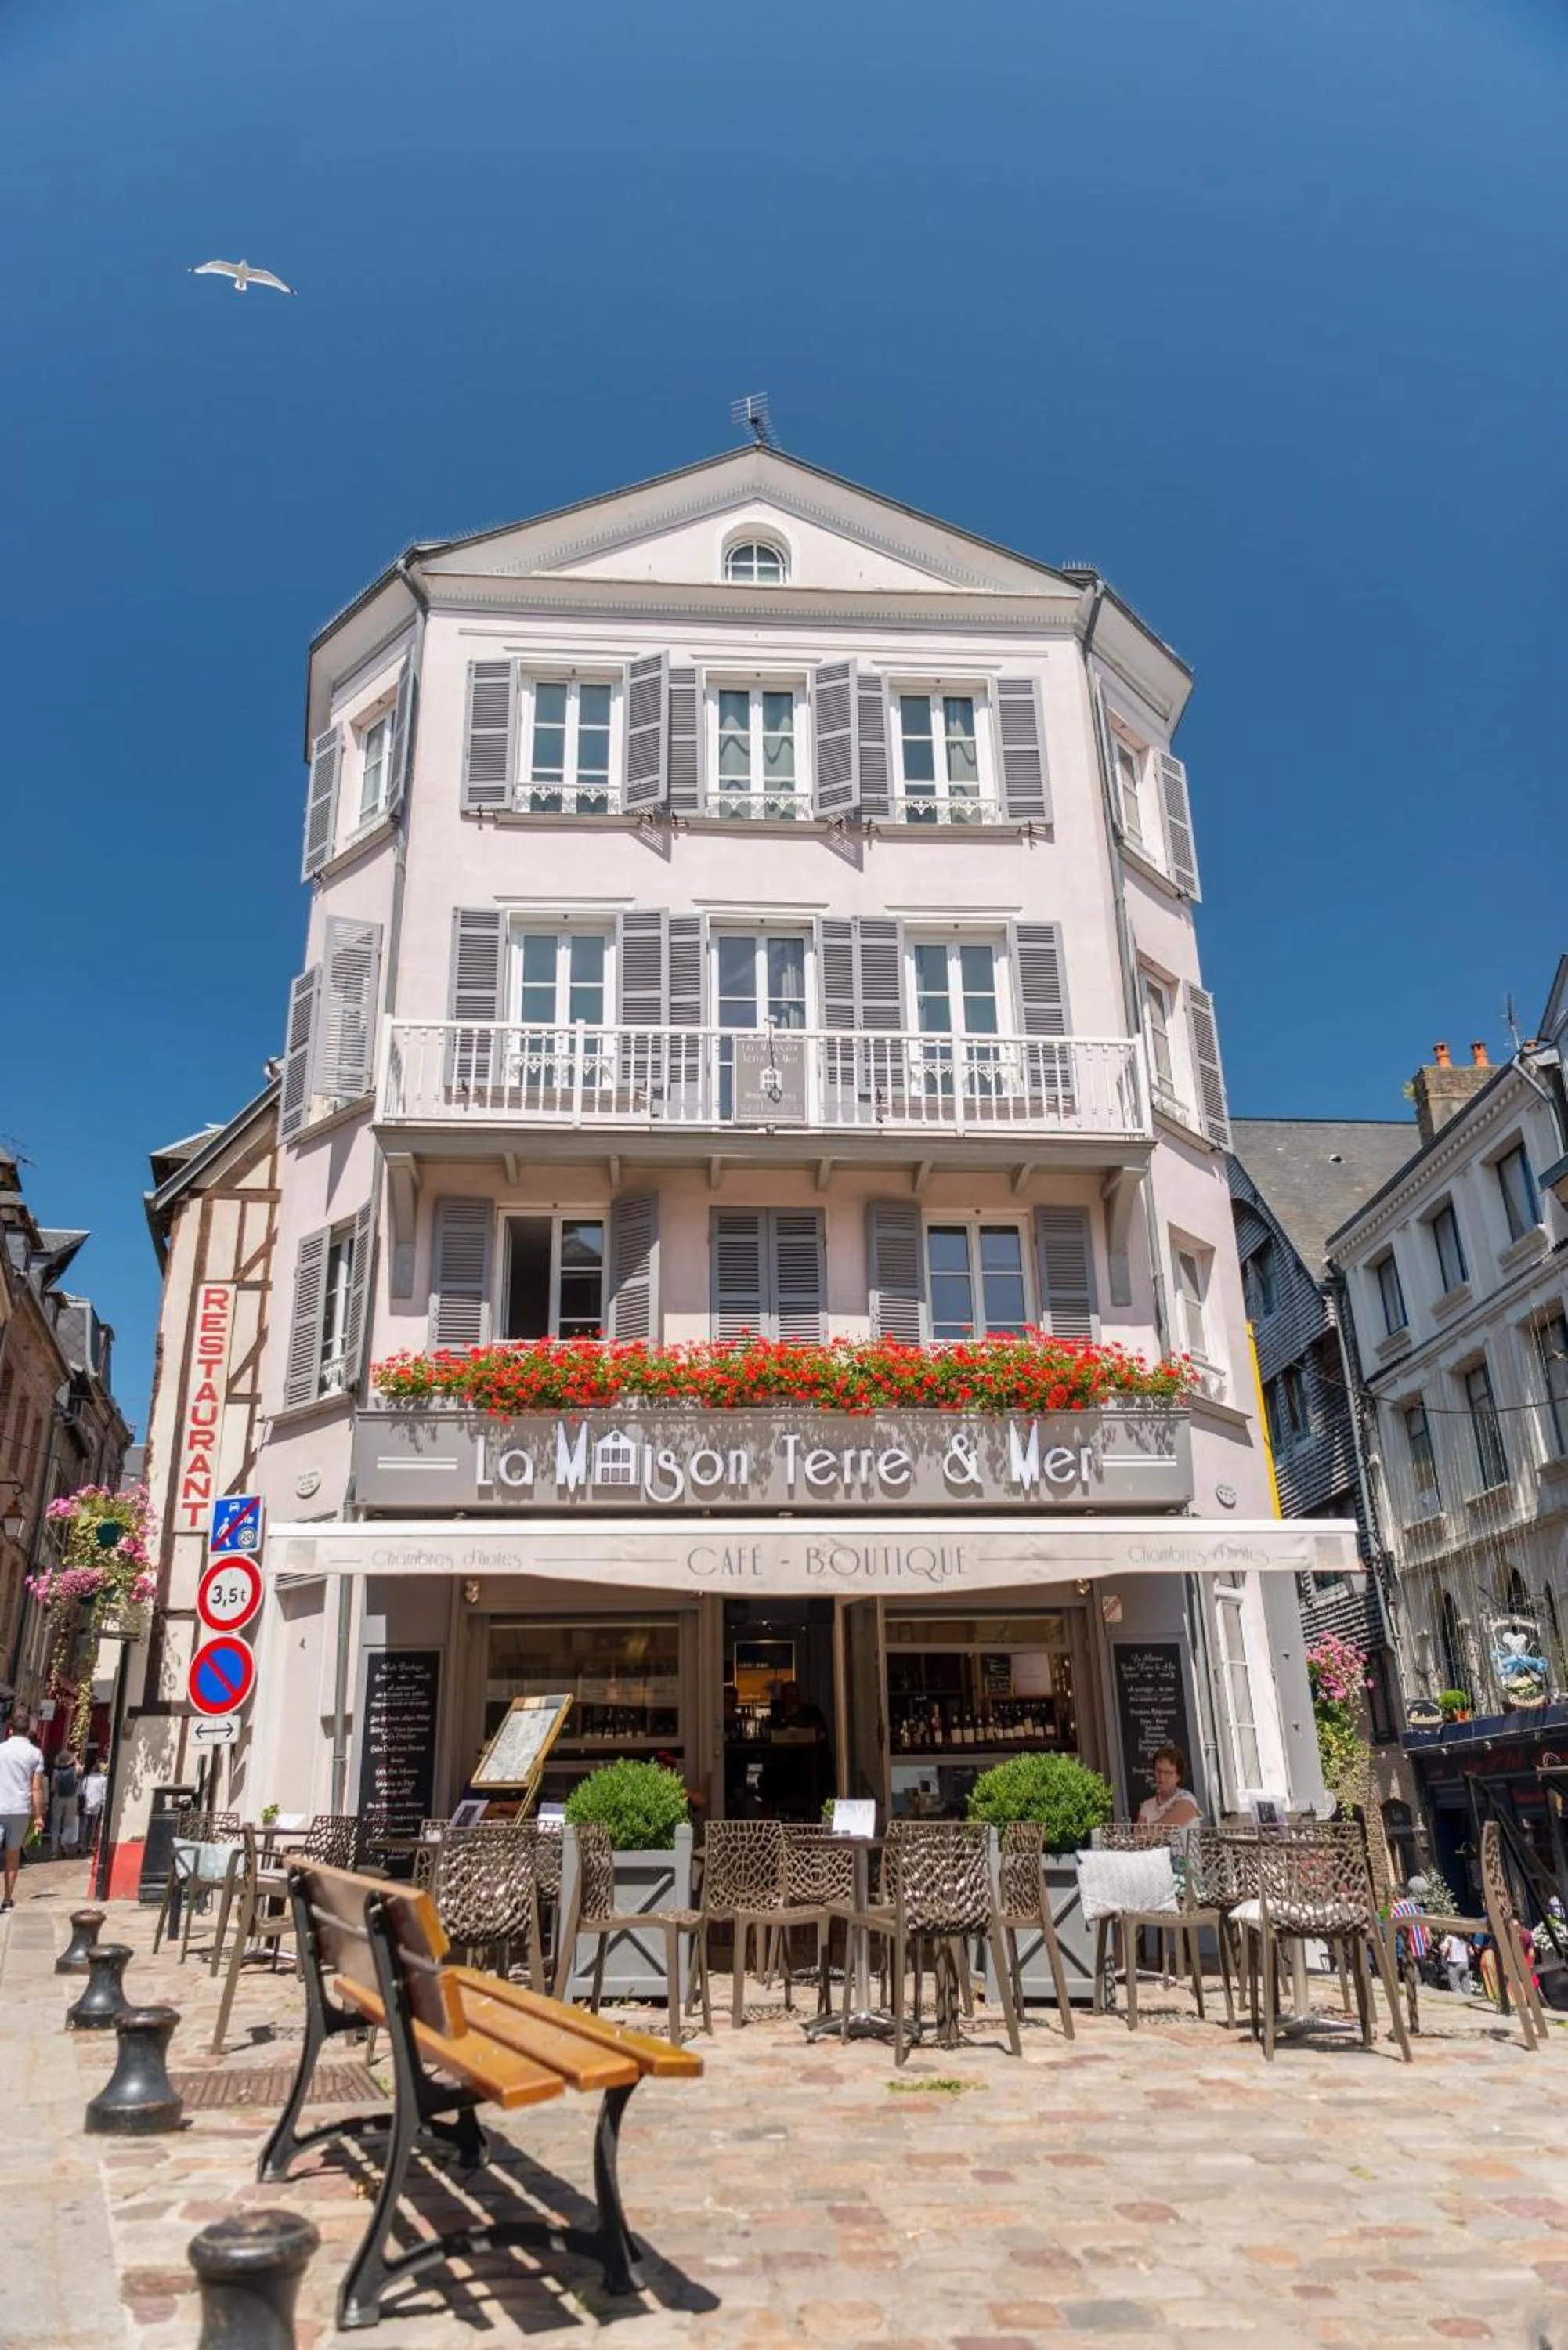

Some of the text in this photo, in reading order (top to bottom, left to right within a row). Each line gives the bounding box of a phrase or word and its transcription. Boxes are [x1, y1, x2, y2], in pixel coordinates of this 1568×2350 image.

[182, 1287, 229, 1528] RESTAURANT
[476, 1434, 533, 1486] La
[782, 1434, 910, 1484] Terre
[943, 1434, 982, 1484] &
[1010, 1419, 1092, 1490] Mer
[242, 1532, 252, 1542] 20
[687, 1544, 764, 1576] CAFÉ
[806, 1546, 966, 1582] BOUTIQUE
